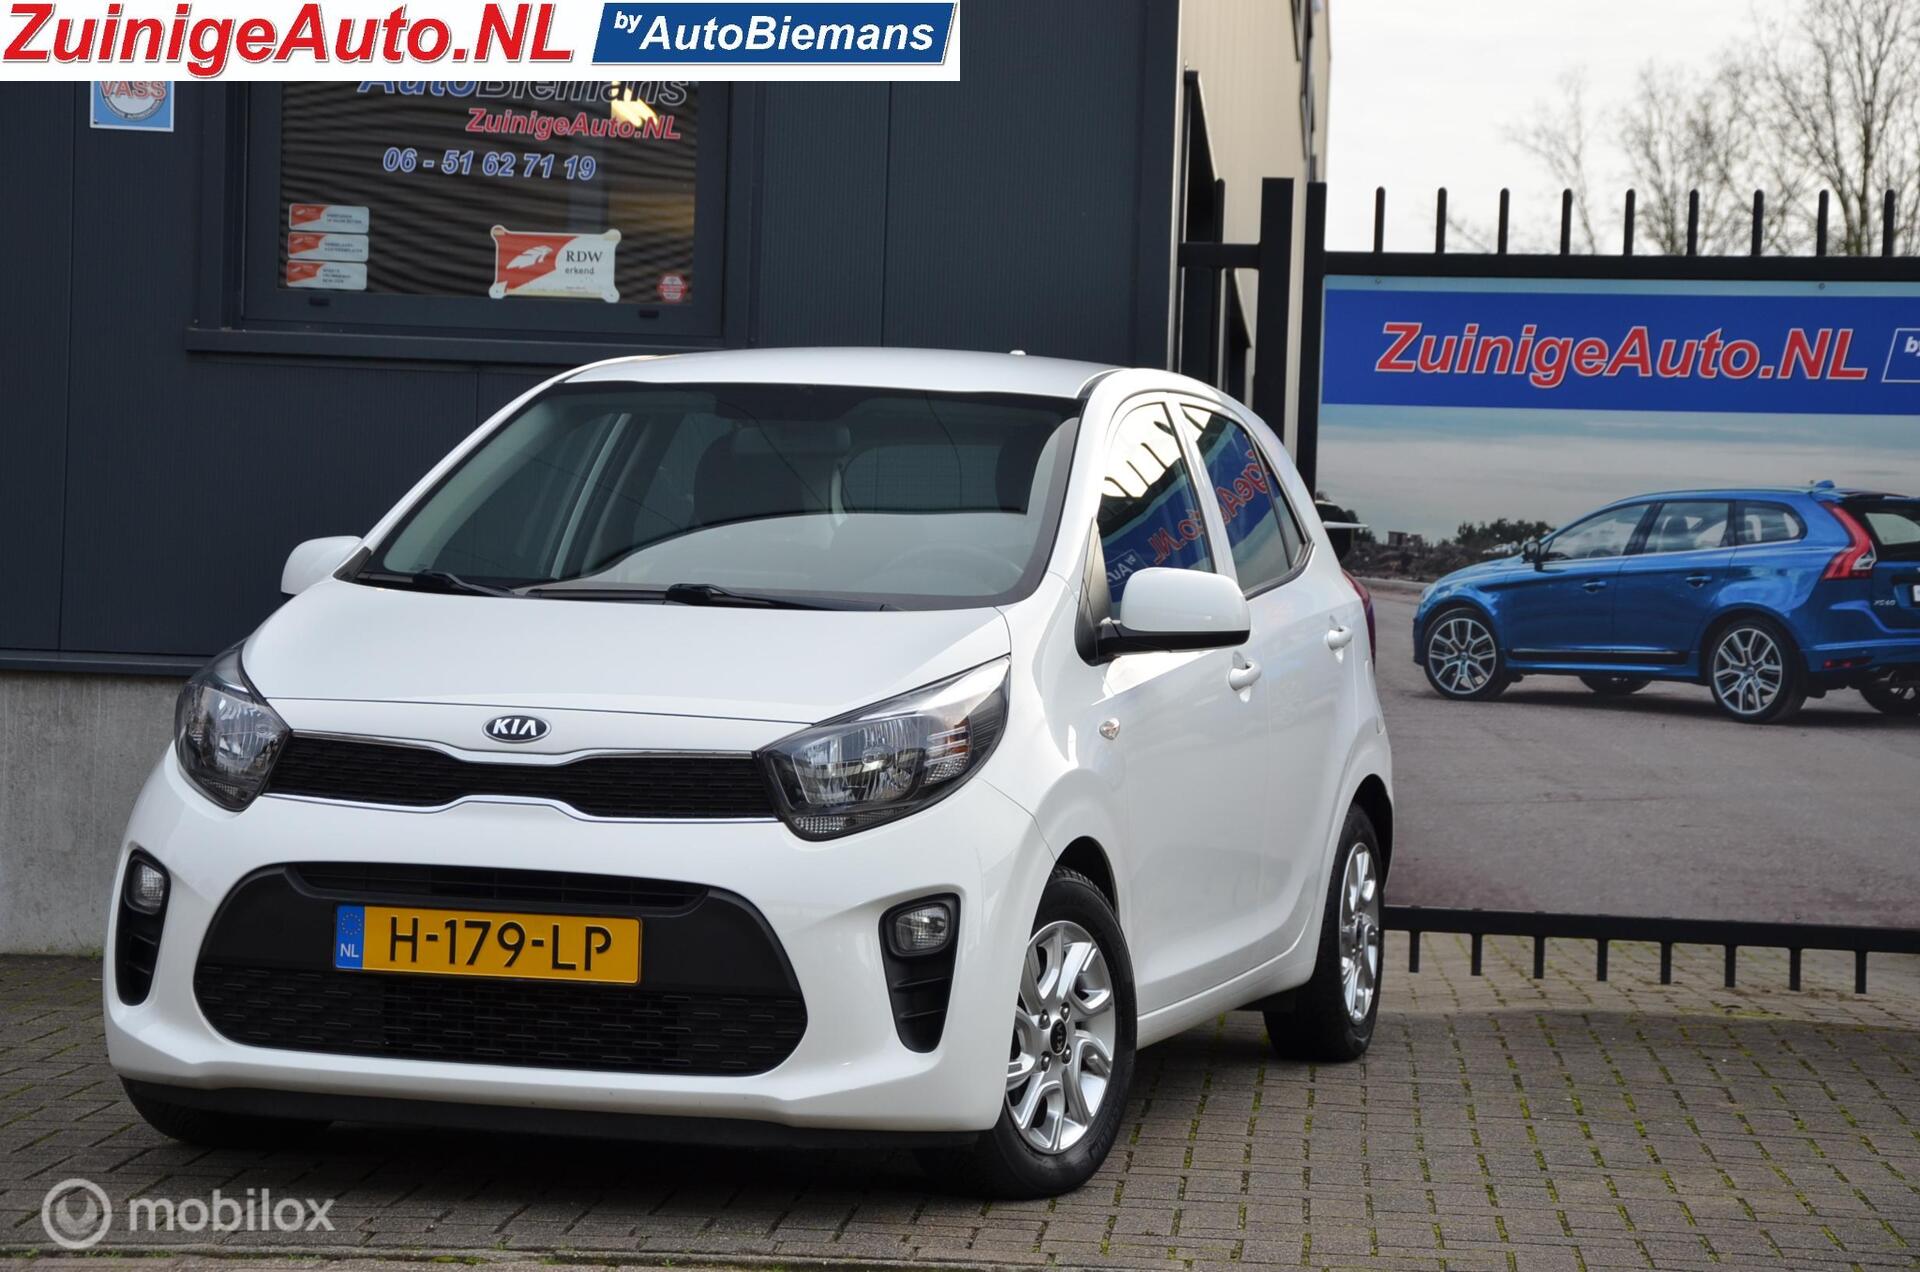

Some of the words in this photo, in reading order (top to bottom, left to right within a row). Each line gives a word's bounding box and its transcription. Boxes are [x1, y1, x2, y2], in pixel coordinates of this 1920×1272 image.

[100, 81, 167, 100] VASS
[465, 108, 681, 141] ZuinigeAuto.NL
[383, 147, 417, 173] 06
[441, 150, 474, 176] 51
[482, 152, 517, 178] 62
[523, 153, 555, 179] 71
[564, 155, 597, 181] 19
[565, 250, 603, 263] RDW
[565, 266, 595, 275] erkend
[1375, 322, 1868, 388] ZuinigeAuto.NL
[493, 718, 537, 736] KIA
[340, 943, 359, 958] NL
[389, 915, 613, 972] H-179-LP
